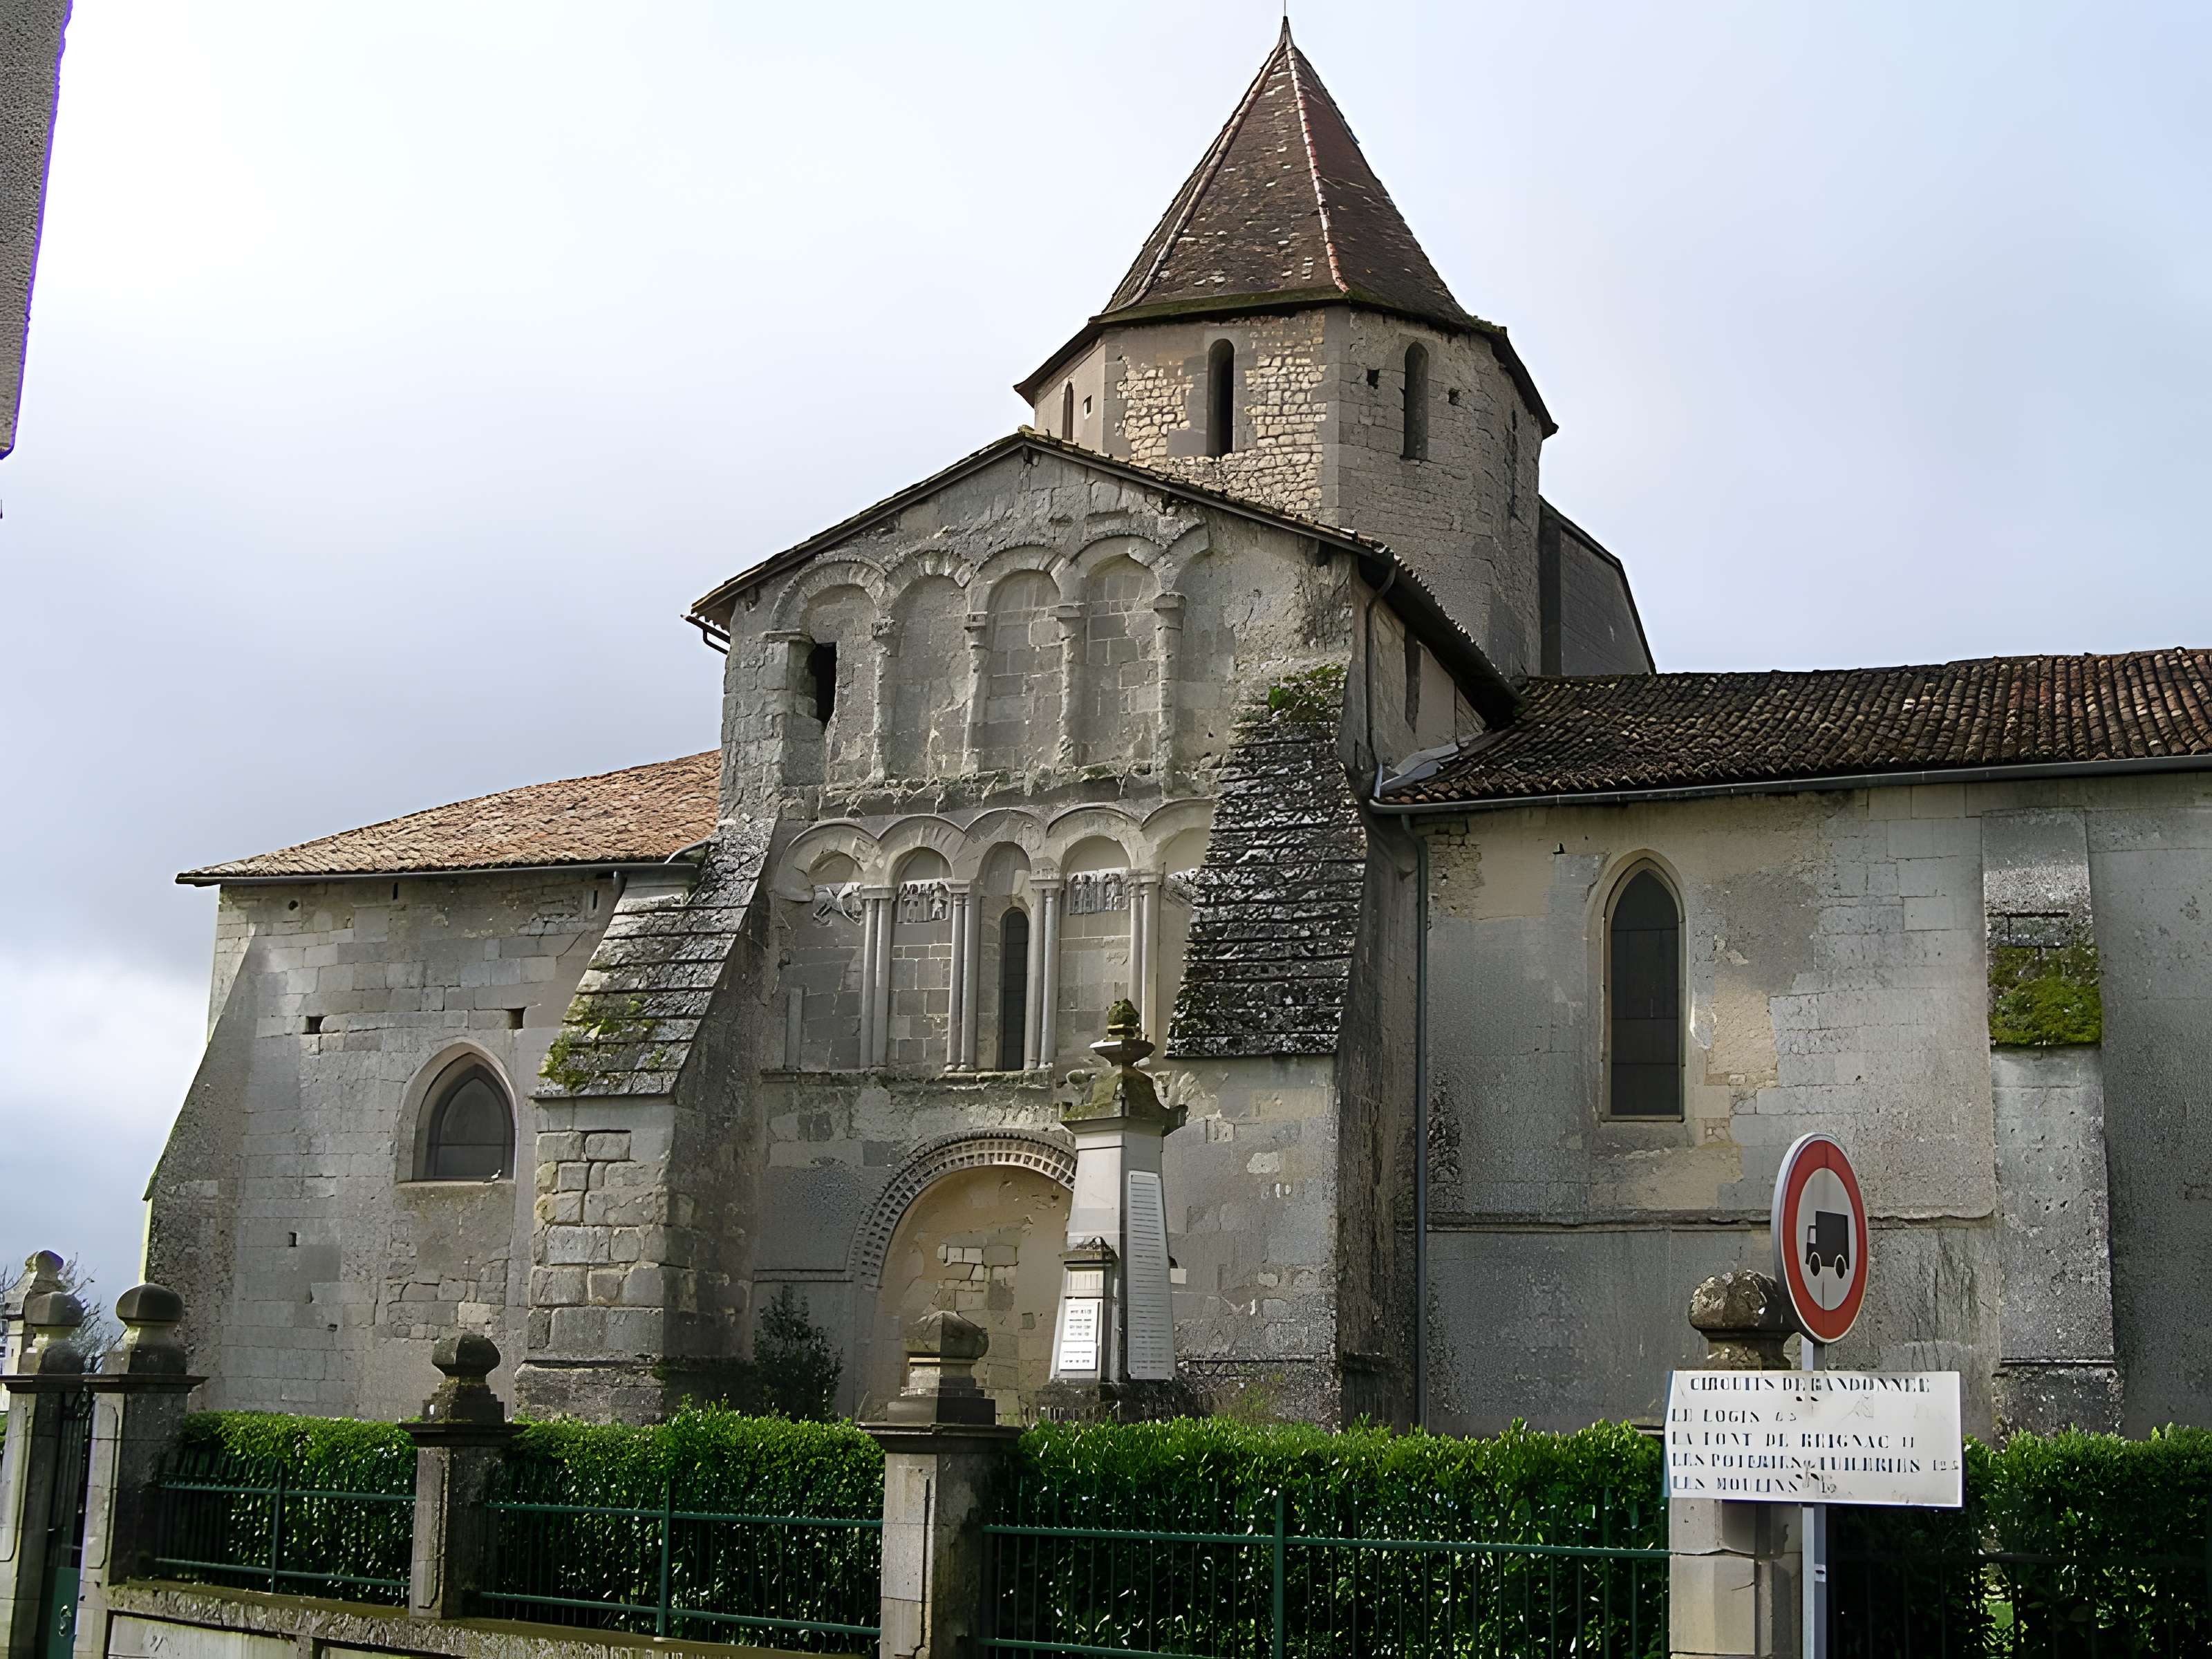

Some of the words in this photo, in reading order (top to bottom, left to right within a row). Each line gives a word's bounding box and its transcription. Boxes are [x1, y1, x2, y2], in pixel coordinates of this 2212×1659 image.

[1672, 1408, 1692, 1422] LE
[1672, 1432, 1693, 1445] LA
[1766, 1434, 1788, 1447] DE
